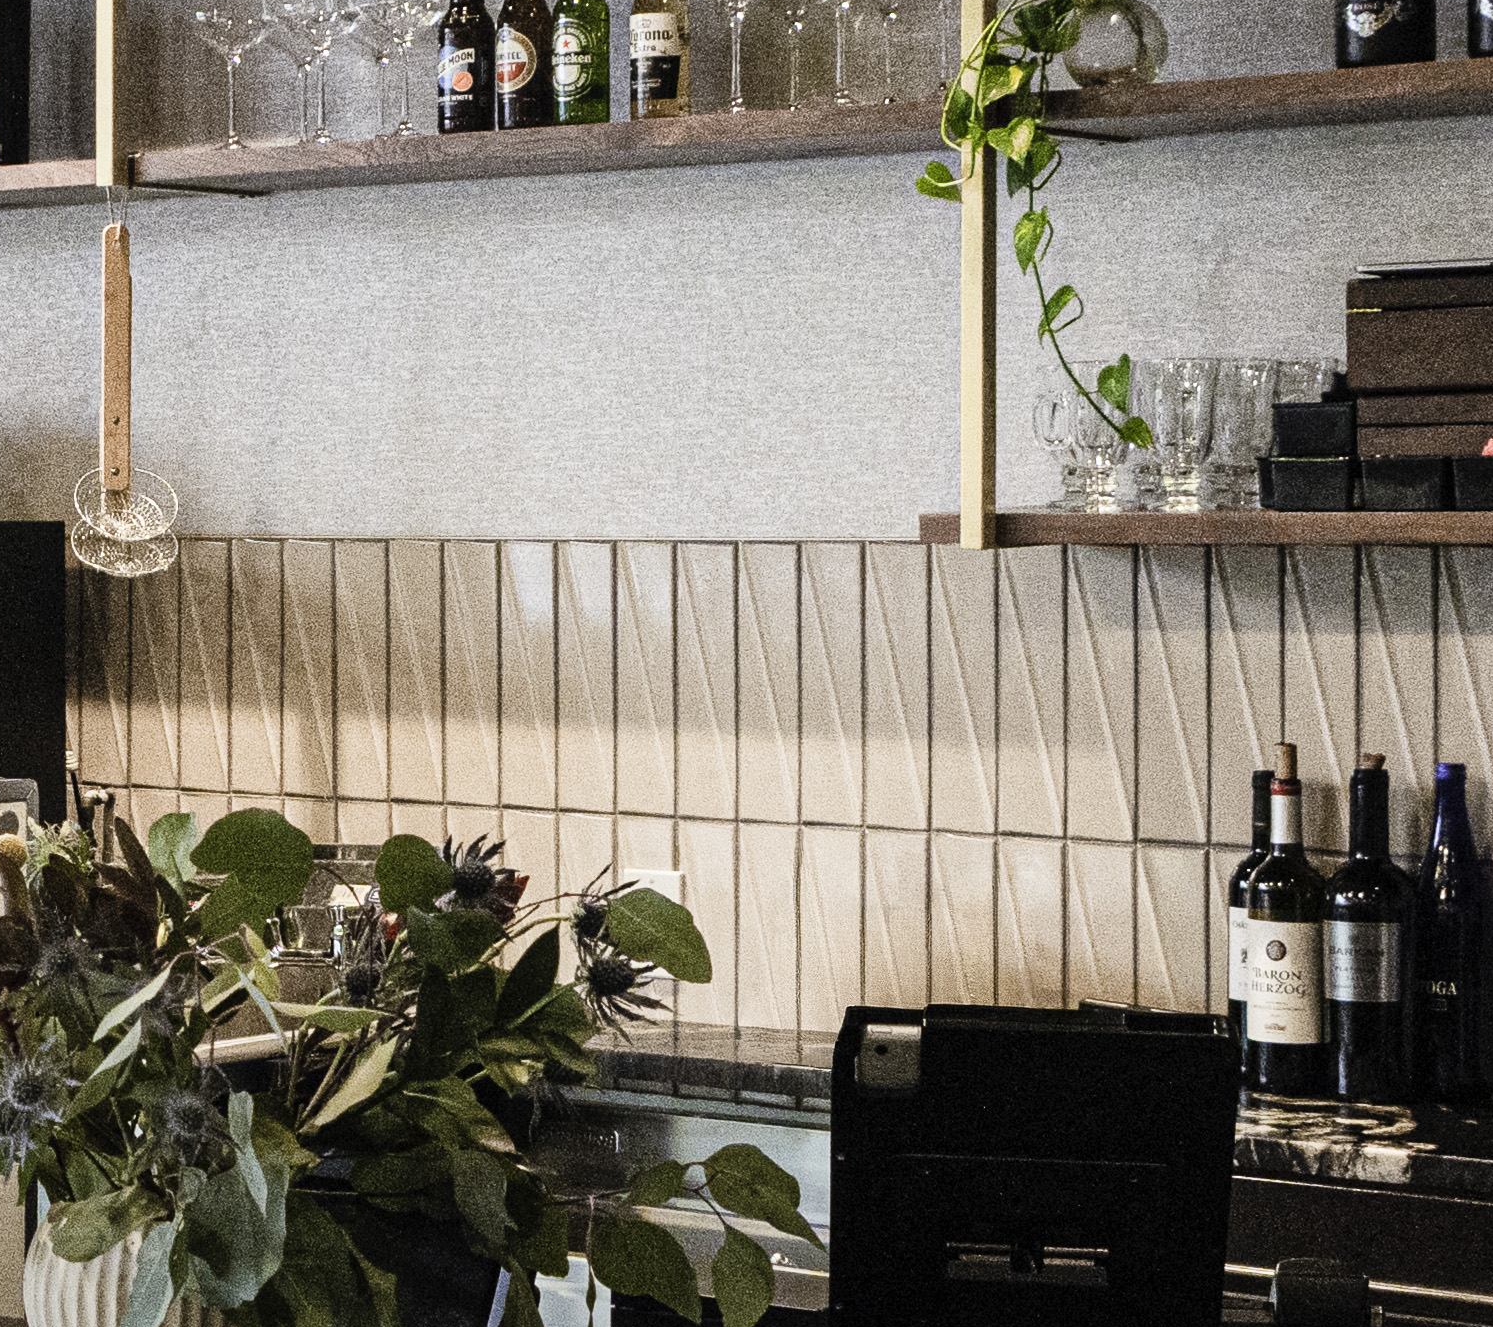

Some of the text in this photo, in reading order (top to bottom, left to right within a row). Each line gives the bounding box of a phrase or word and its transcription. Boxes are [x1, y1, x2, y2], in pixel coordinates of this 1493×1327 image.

[447, 50, 474, 66] MOON
[552, 52, 592, 65] ineken
[1252, 967, 1302, 984] BARON
[1251, 980, 1307, 999] HERZOG
